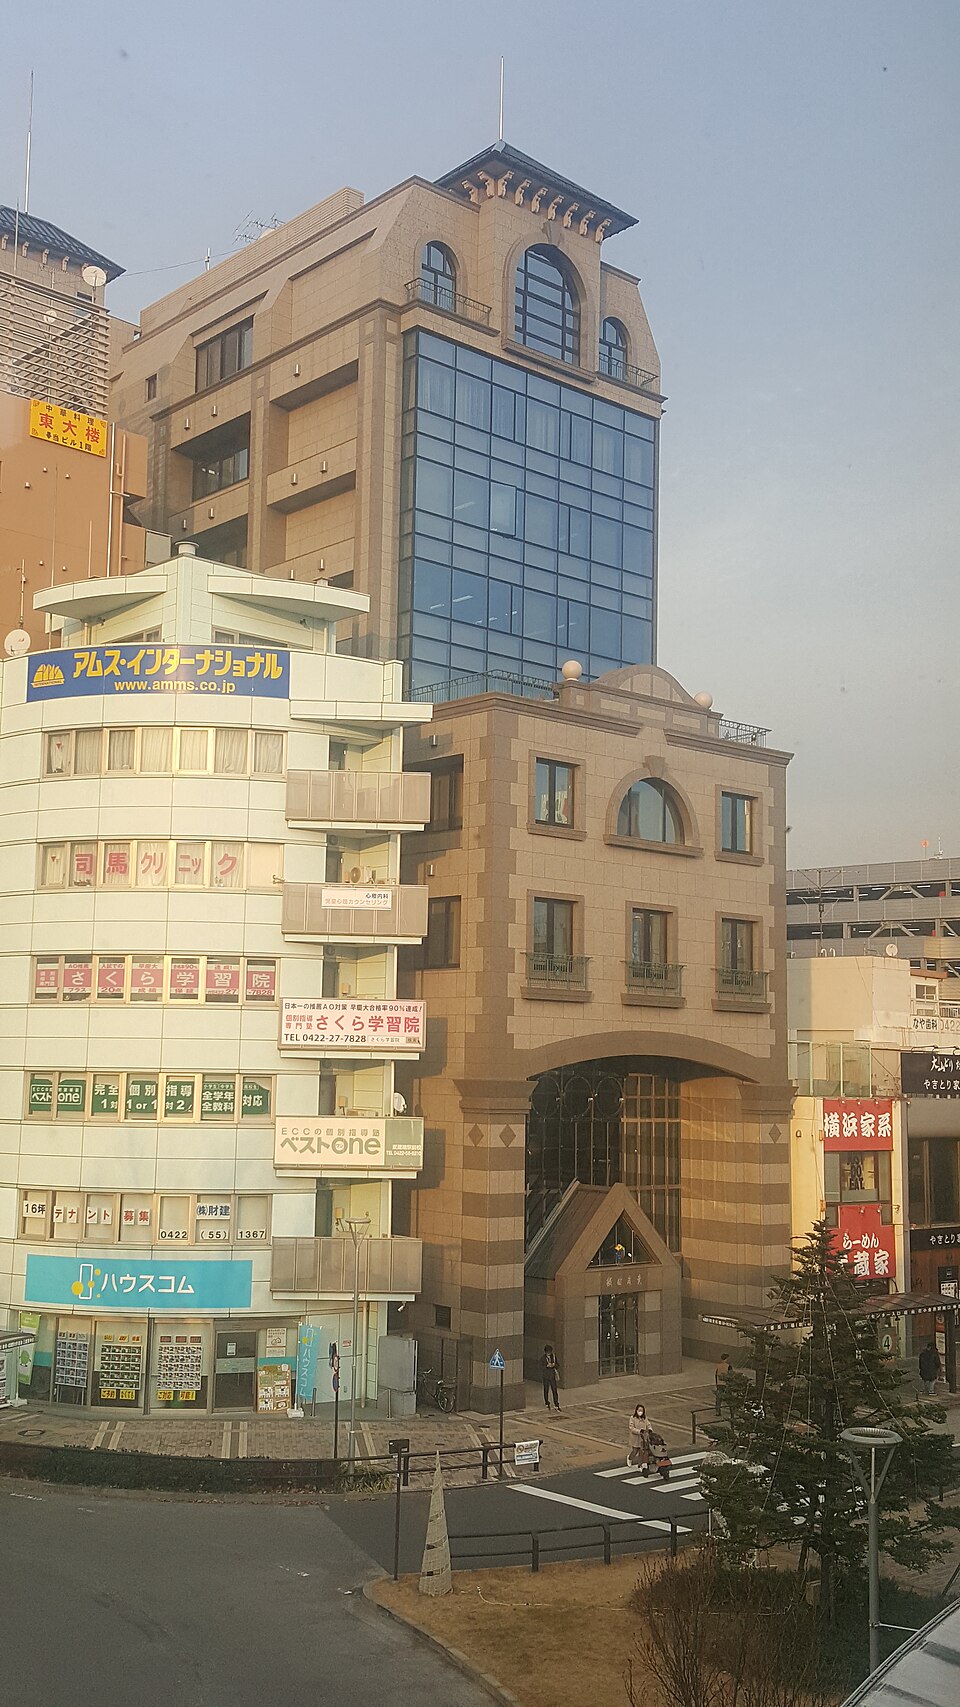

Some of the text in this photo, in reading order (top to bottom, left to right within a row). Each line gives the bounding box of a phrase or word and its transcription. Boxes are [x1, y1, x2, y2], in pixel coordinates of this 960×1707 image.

[45, 405, 95, 426] 中華料理
[39, 412, 100, 444] 東大楼
[73, 650, 283, 679] アムス・インターナショナル
[114, 680, 236, 693] www.amms.co.jp
[75, 852, 237, 876] 司馬クリニック
[71, 971, 270, 988] さくら学習院
[285, 1014, 313, 1022] 個別指導
[316, 1015, 420, 1033] さくら学習院
[913, 1018, 938, 1031] なや歯科
[285, 1022, 313, 1030] 専門塾
[284, 1033, 367, 1043] TEL 0422-27-7828
[202, 1091, 235, 1101] 全学年
[242, 1094, 264, 1107] 対応
[201, 1101, 235, 1112] 全教科
[823, 1112, 892, 1138] 横浜家系
[281, 1127, 380, 1137] ECCの個別指導塾
[25, 1203, 46, 1214] 16坪
[160, 1230, 188, 1239] 0422
[239, 1230, 265, 1239] 1367
[842, 1232, 880, 1250] らーめん
[101, 1273, 195, 1294] ハウスコム
[883, 1336, 891, 1350] 4
